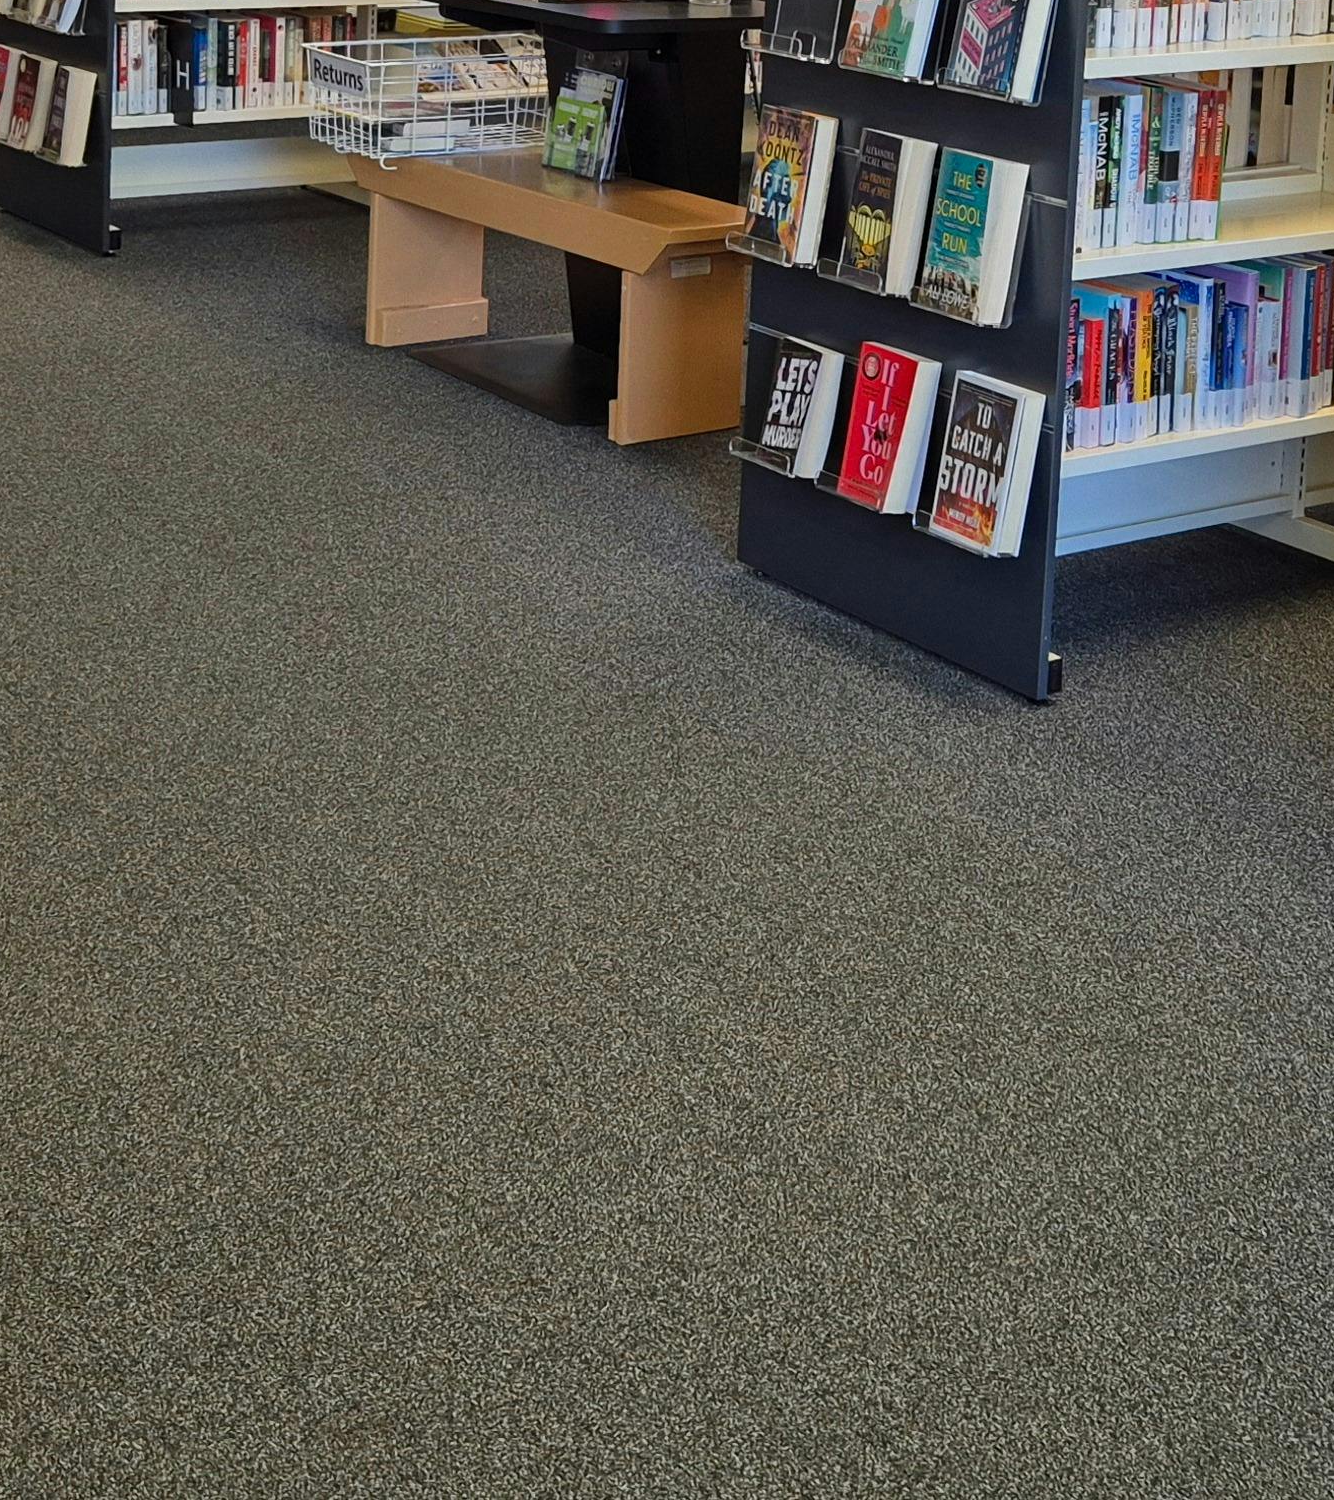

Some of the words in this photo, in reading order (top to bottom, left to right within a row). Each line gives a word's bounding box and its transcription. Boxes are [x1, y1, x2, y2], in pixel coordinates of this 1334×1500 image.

[176, 61, 191, 91] H
[313, 58, 364, 92] Returns
[768, 120, 801, 143] DEAN
[752, 171, 799, 198] AFTER
[953, 170, 972, 192] THE
[748, 193, 795, 225] DEATH
[936, 197, 984, 228] SCHOOL
[941, 231, 968, 255] RUN
[776, 356, 818, 391] LET'S
[880, 358, 900, 388] If
[767, 389, 811, 427] PLAY
[882, 386, 890, 412] I
[867, 401, 897, 434] Let
[976, 401, 993, 430] TO
[762, 424, 802, 450] MURDER
[860, 423, 892, 461] You
[950, 425, 992, 456] CATCH
[993, 441, 1006, 467] A
[859, 454, 885, 485] Go
[939, 455, 1002, 511] STORM
